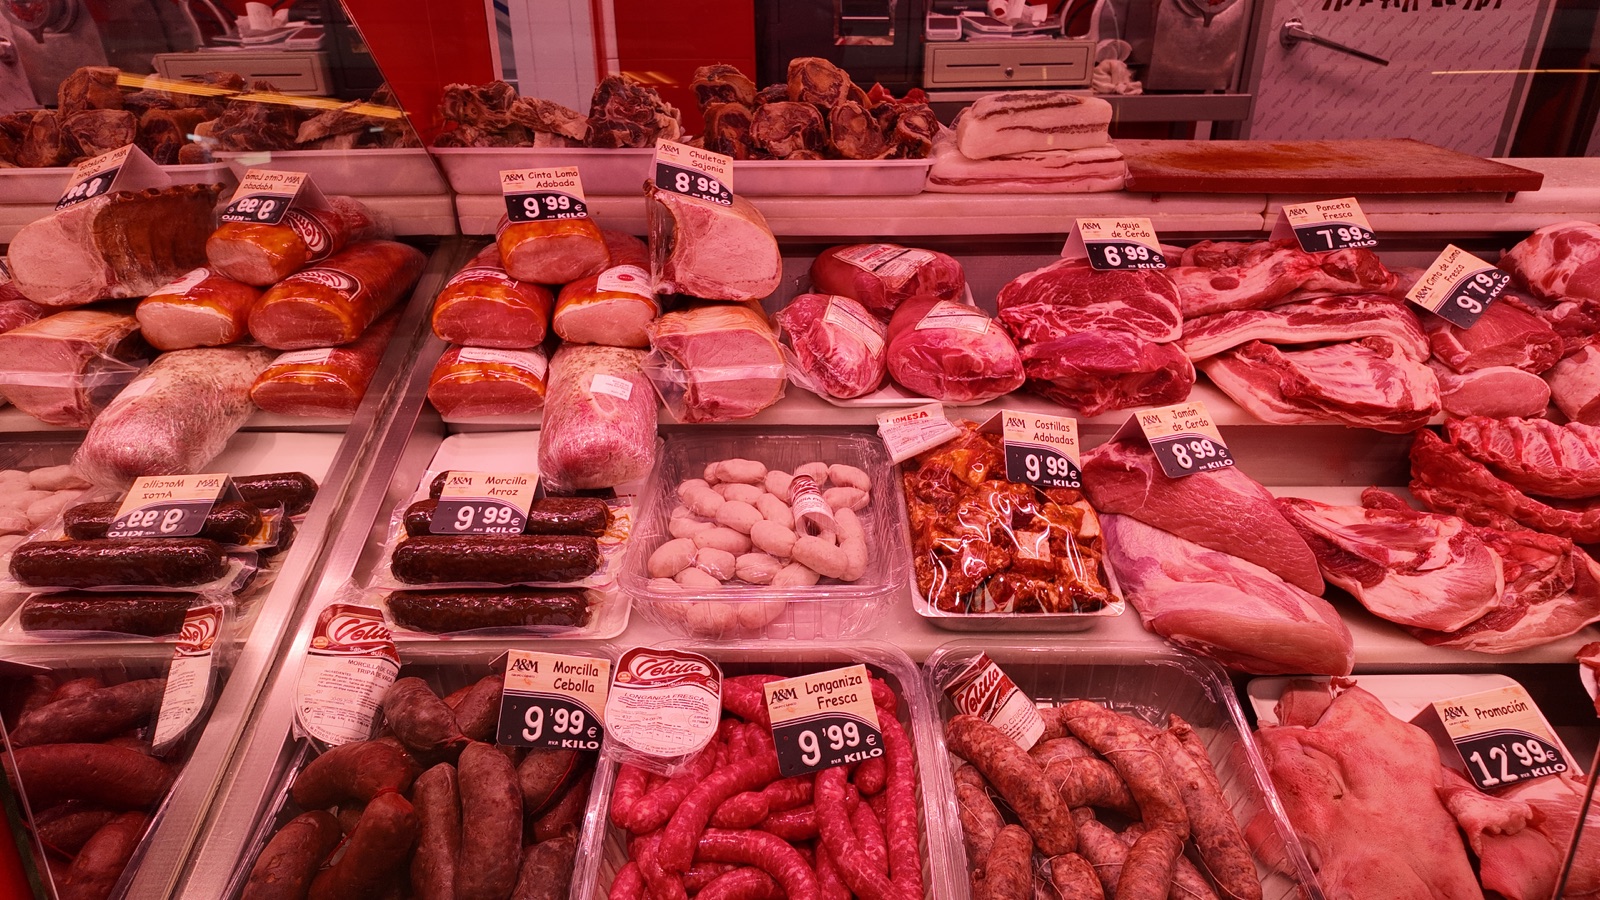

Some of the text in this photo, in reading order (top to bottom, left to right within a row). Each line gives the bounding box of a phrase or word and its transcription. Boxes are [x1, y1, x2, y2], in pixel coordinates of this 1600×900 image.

[659, 144, 680, 155] A&M
[689, 151, 727, 166] Chuletas
[691, 160, 724, 174] Sajonia
[503, 173, 525, 182] A&M
[528, 170, 578, 180] Cinta Lomo
[536, 179, 575, 188] Adobada
[702, 194, 732, 205] KILO
[1288, 208, 1308, 217] A&M
[1316, 203, 1350, 211] Panceta
[557, 211, 587, 219] KILO
[1322, 212, 1353, 220] Fresca
[1082, 222, 1102, 230] A&M
[1115, 222, 1140, 231] Aguja
[1349, 239, 1377, 248] KILO
[1426, 249, 1461, 286] Cinta de Lomo
[1444, 264, 1465, 283] Fresca
[1490, 275, 1510, 298] KILO
[1172, 407, 1198, 419] Jamón
[1005, 417, 1027, 429] A&M
[1035, 419, 1070, 432] Costillas
[1172, 418, 1209, 431] de Cerdo
[1033, 432, 1075, 445] Adobadas
[1207, 459, 1233, 469] KILO
[446, 476, 474, 486] A&M
[485, 476, 528, 486] Morcilla
[1053, 479, 1080, 488] KILO
[487, 486, 519, 496] Arroz
[508, 658, 539, 674] A&M
[553, 660, 599, 677] Morcilla
[636, 658, 703, 677] Velilla
[553, 678, 595, 693] Cebolla
[805, 675, 863, 695] Longaniza
[769, 687, 799, 706] A&M
[816, 693, 858, 710] Fresca
[1443, 705, 1469, 722] A&M
[1474, 699, 1529, 720] Promoción
[561, 739, 600, 750] KILO
[844, 747, 883, 763] KILO
[1530, 763, 1567, 777] KILO
